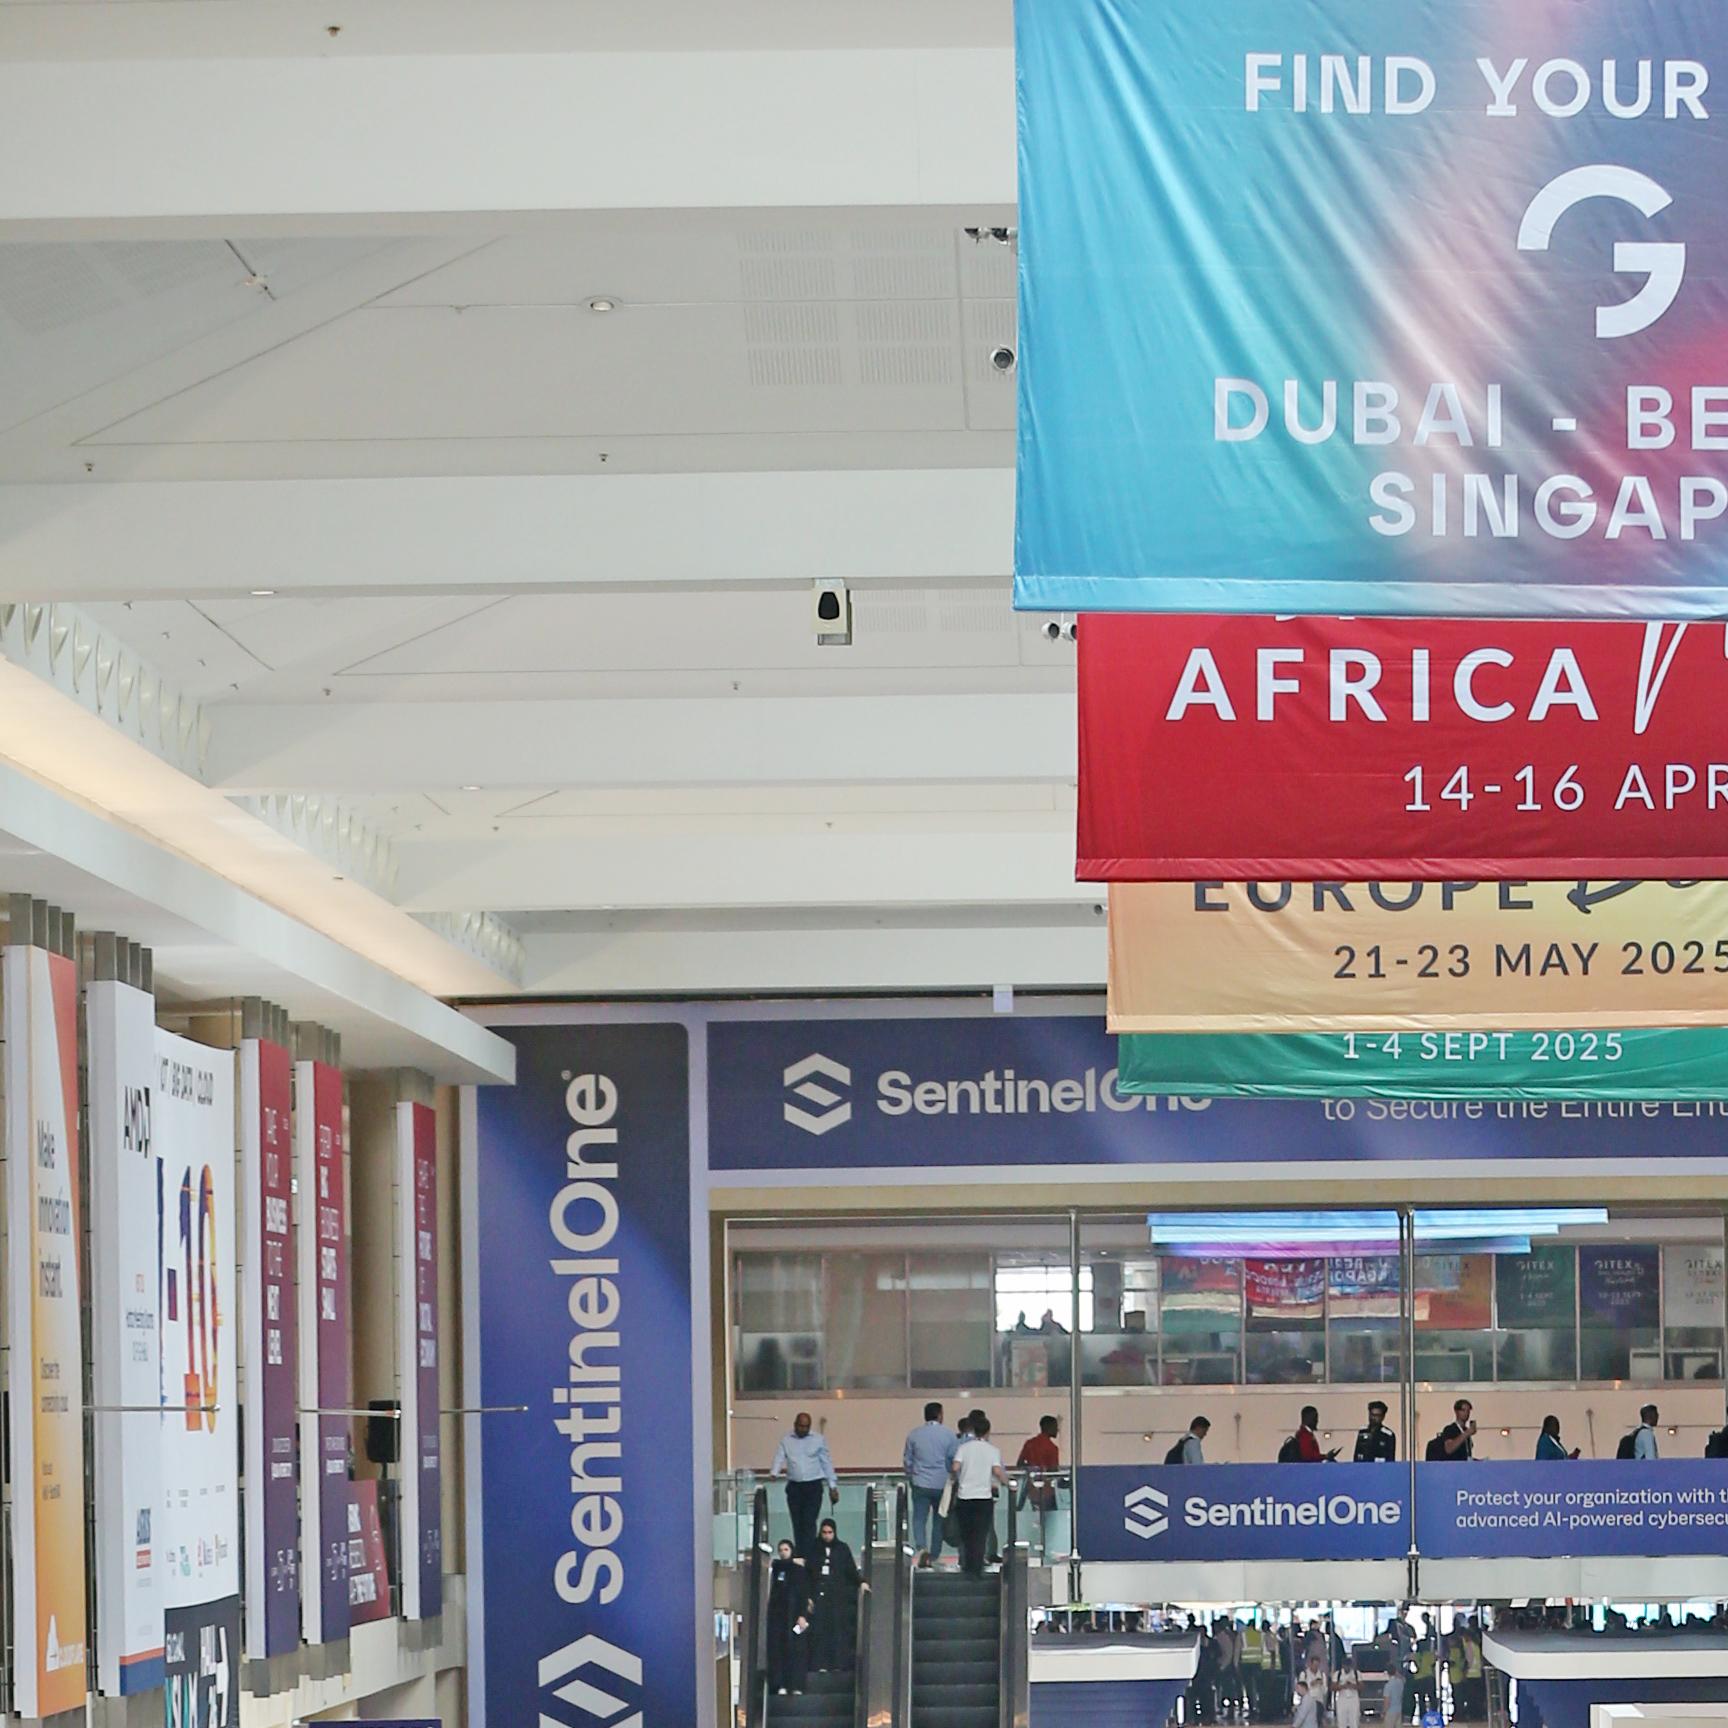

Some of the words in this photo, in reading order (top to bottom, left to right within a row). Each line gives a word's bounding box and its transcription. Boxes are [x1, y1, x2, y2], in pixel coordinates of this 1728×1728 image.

[1241, 52, 1438, 119] FIND
[1479, 53, 1709, 120] YOUR
[1211, 376, 1505, 447] DUBAI
[1164, 647, 1601, 723] AFRICA
[1401, 764, 1587, 813] 14-16
[1332, 944, 1473, 979] 21-23
[1493, 942, 1603, 978] MAY
[1341, 1030, 1404, 1063] 1-4
[1420, 1031, 1513, 1063] SEPT
[1530, 1030, 1625, 1063] 2025
[1322, 1099, 1356, 1121] to
[1365, 1098, 1484, 1122] Secure
[37, 1119, 56, 1170] Make
[548, 1070, 626, 1605] SentinelOne
[1182, 1493, 1401, 1527] SentinelOne
[1456, 1488, 1520, 1508] Protect
[1523, 1492, 1561, 1509] your
[1564, 1486, 1673, 1510] organization
[1676, 1486, 1715, 1504] with
[1455, 1509, 1541, 1528] advanced
[1542, 1509, 1645, 1531] AI-powered
